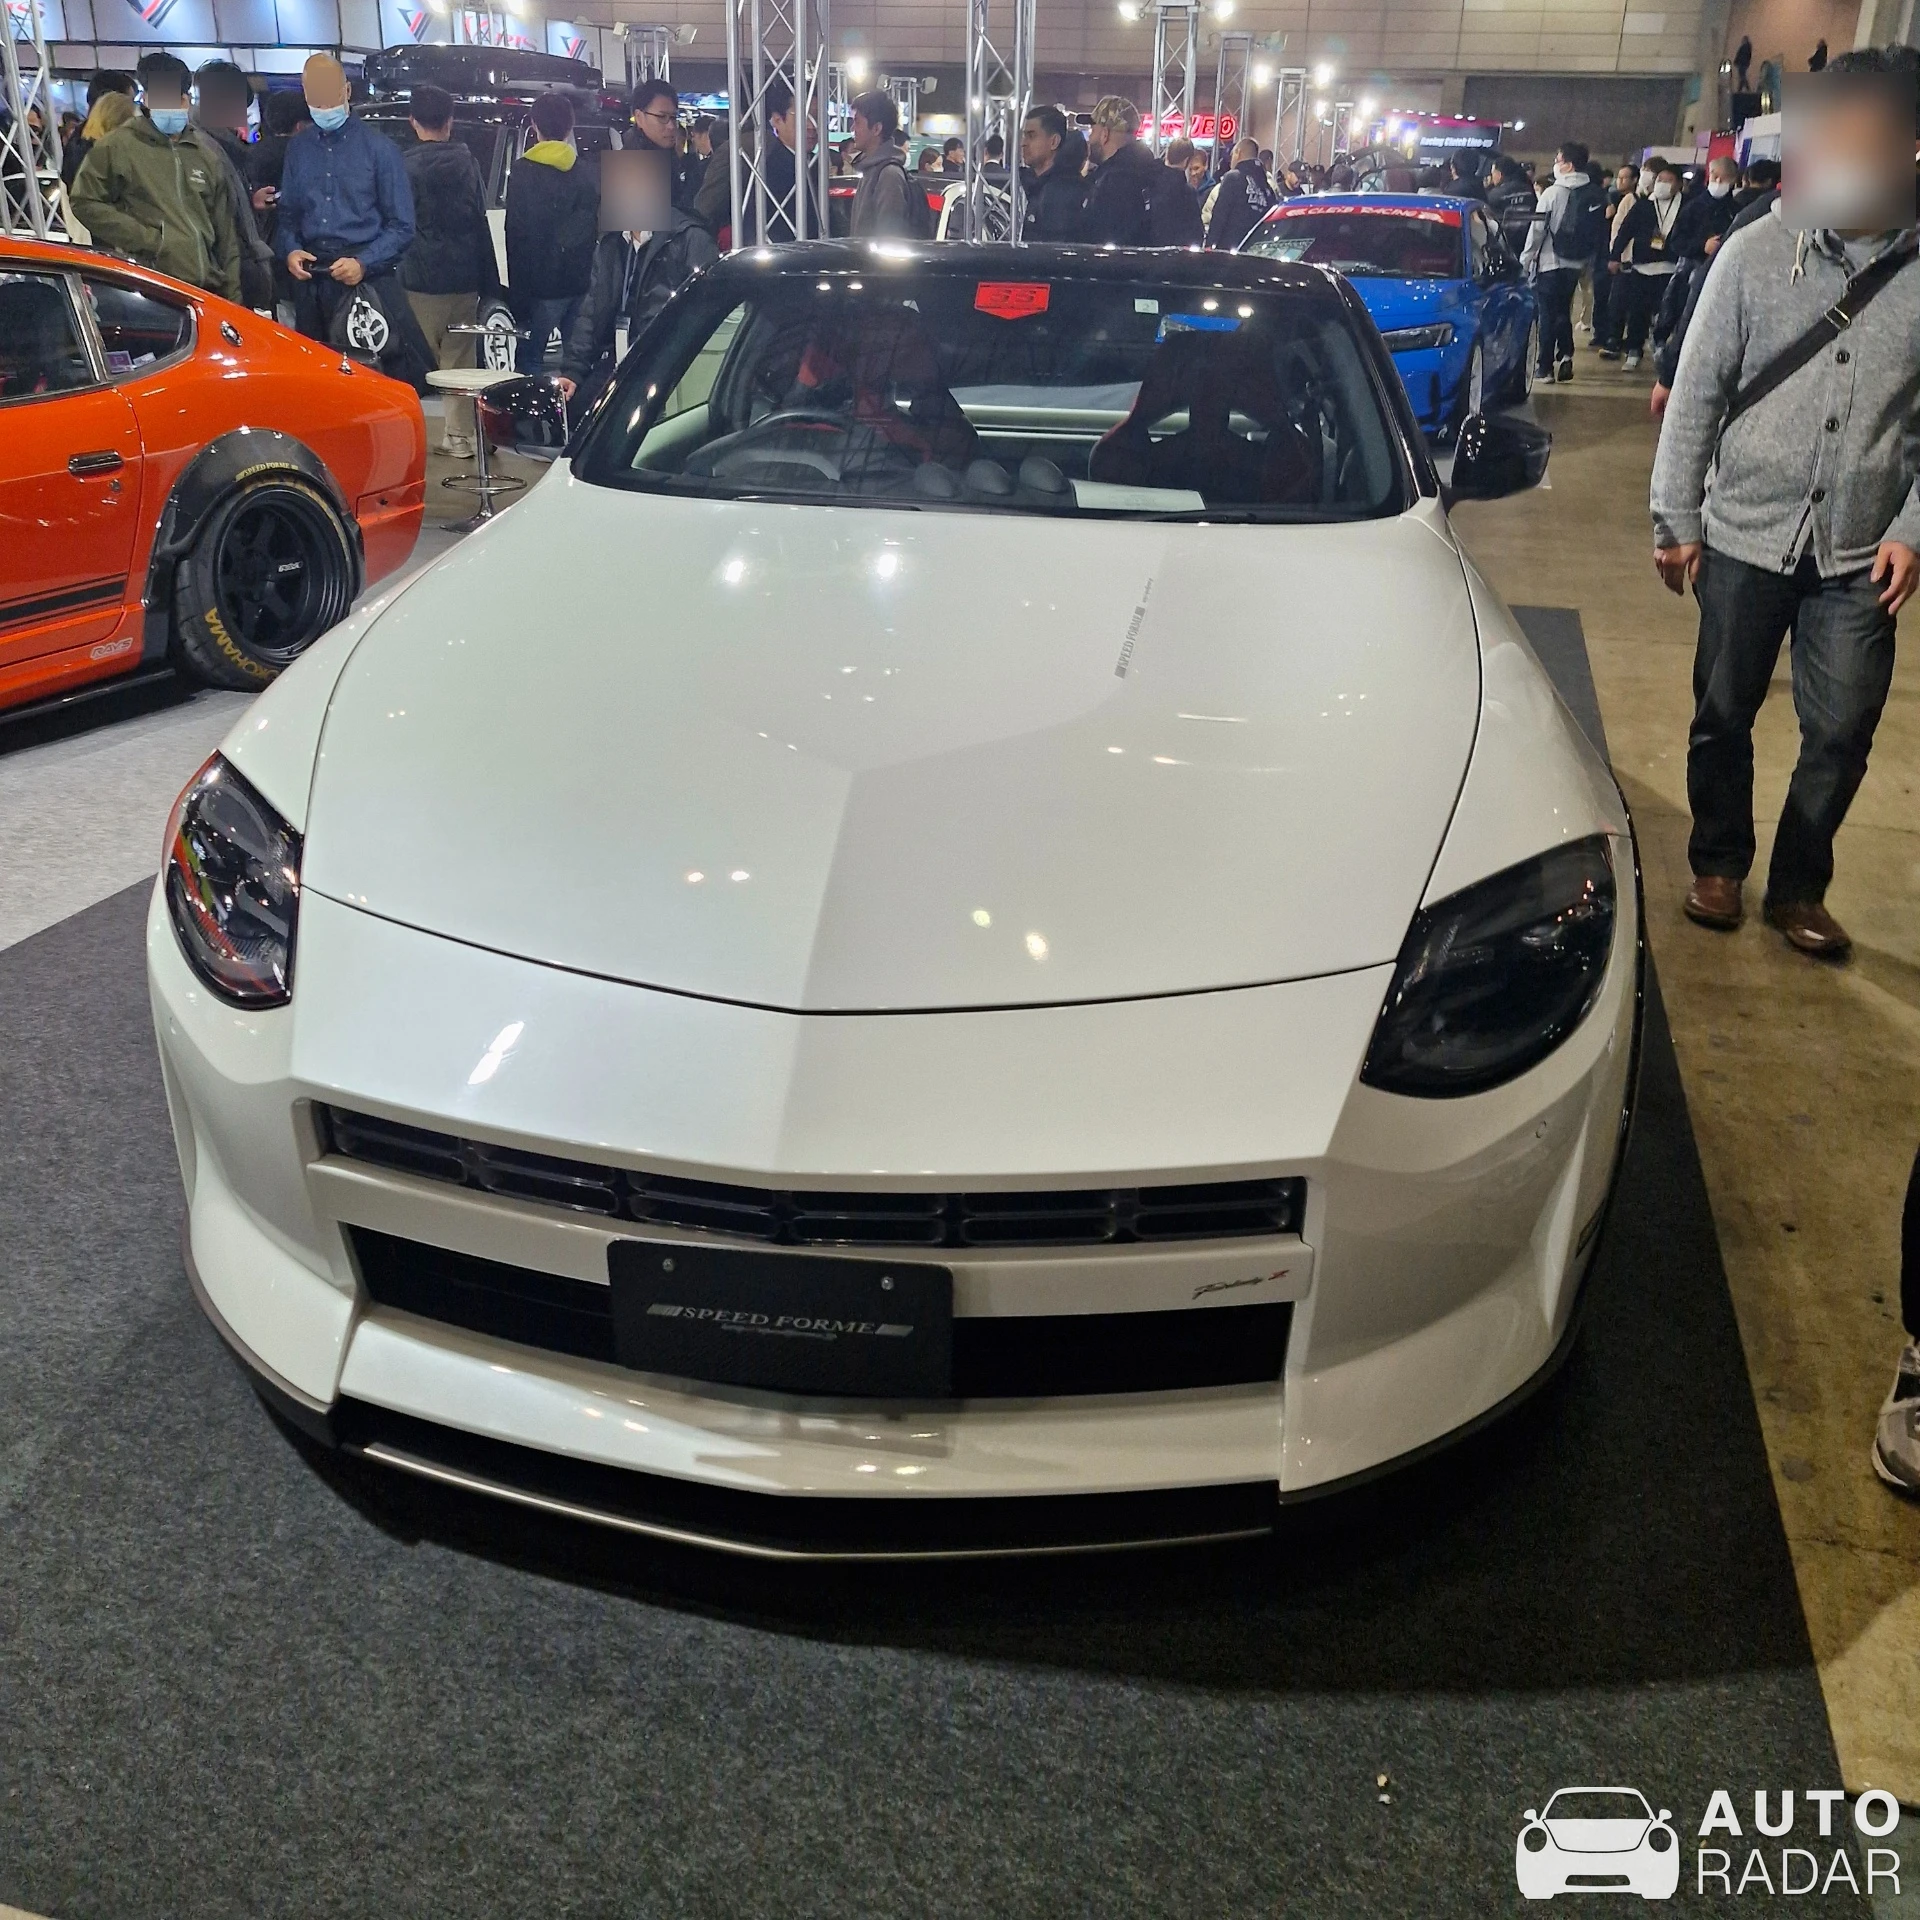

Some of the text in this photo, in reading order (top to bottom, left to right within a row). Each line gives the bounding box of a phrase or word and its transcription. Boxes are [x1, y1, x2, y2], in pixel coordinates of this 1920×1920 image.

[242, 463, 266, 477] SPEED
[91, 638, 133, 659] RAYS
[205, 606, 280, 681] OKOHAMA
[683, 1306, 770, 1325] SPEED
[775, 1315, 876, 1334] FORME
